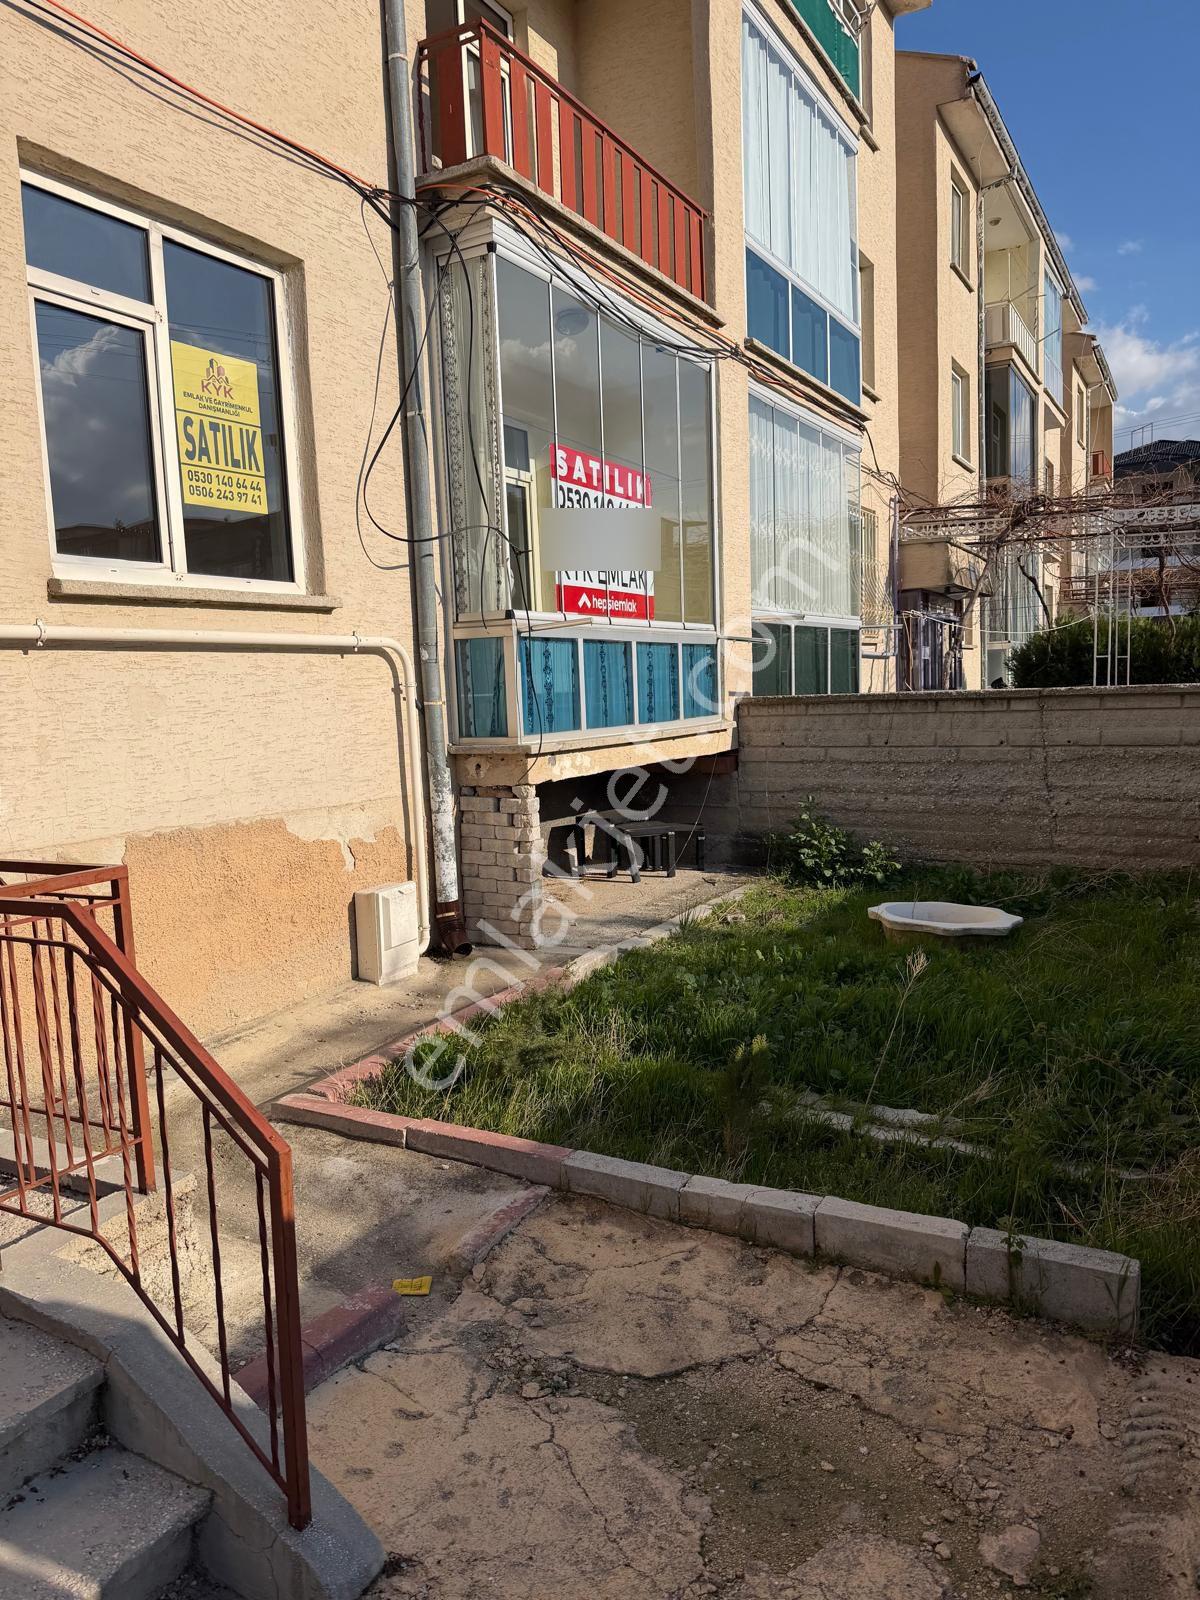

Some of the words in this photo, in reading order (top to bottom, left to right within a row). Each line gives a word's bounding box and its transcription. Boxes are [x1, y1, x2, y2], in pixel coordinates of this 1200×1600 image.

[183, 391, 205, 403] EMLAK
[201, 380, 234, 400] KYK
[183, 416, 261, 473] SATILIK
[187, 469, 213, 485] 0530
[215, 474, 234, 488] 140
[236, 477, 248, 491] 64
[249, 480, 262, 493] 44
[189, 484, 214, 499] 0506
[216, 488, 235, 501] 243
[237, 491, 249, 504] 97
[251, 494, 263, 506] 41
[593, 595, 637, 613] hepsiemlak
